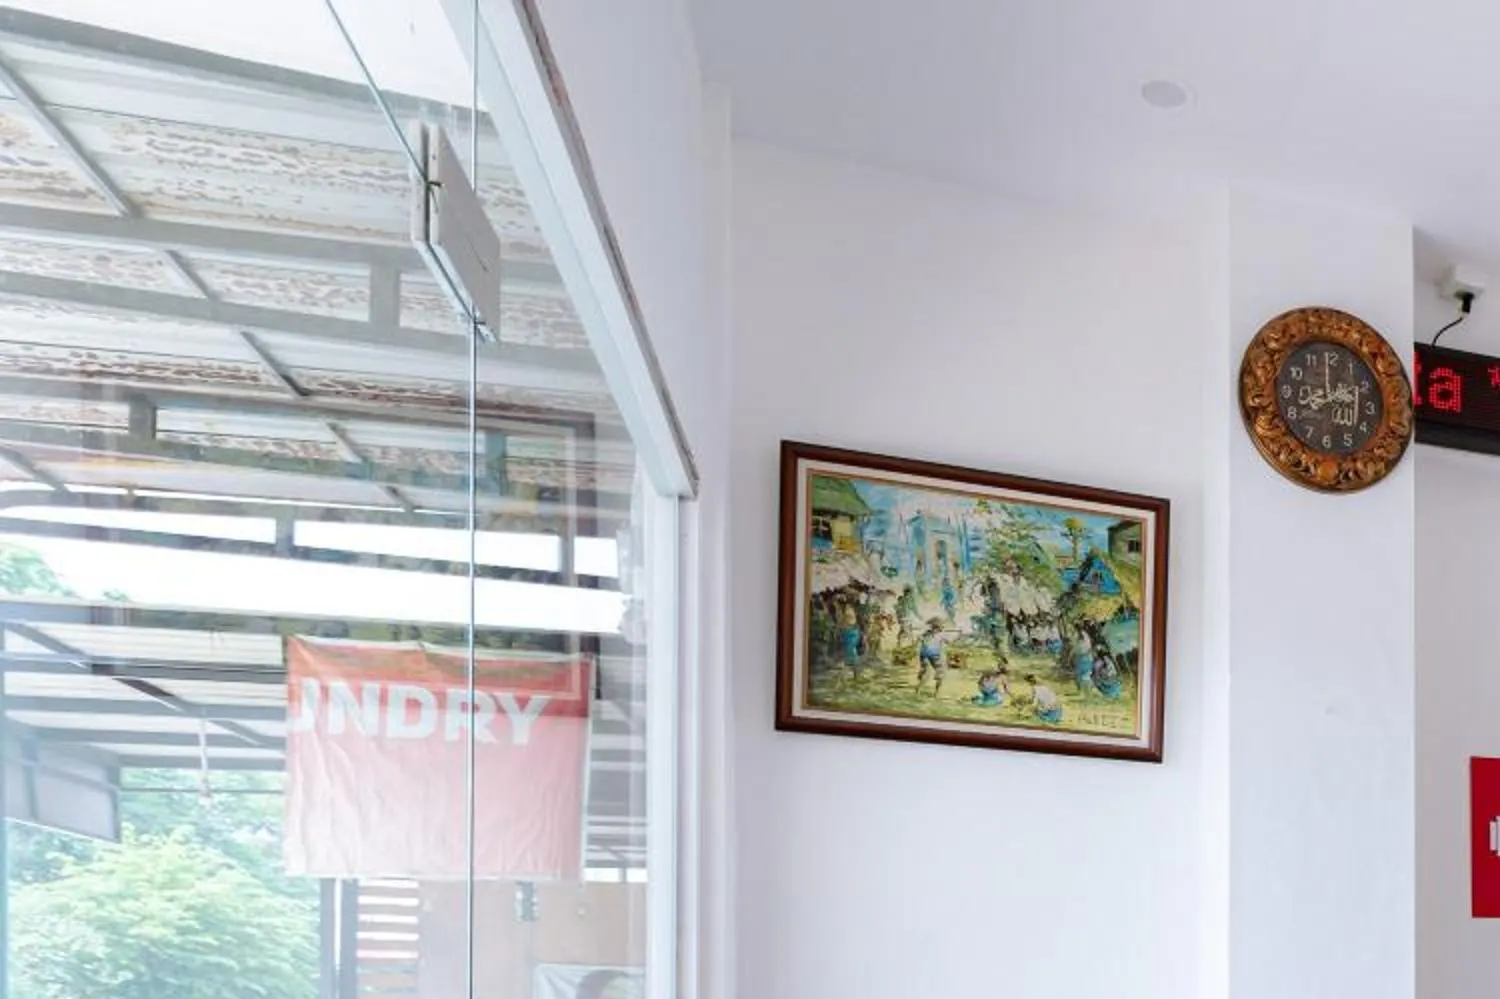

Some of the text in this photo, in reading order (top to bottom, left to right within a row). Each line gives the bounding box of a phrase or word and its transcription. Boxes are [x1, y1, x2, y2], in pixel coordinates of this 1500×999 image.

[1305, 353, 1317, 368] 11
[1290, 366, 1303, 380] 10
[1283, 384, 1292, 399] 9
[1360, 381, 1370, 393] 2
[1288, 406, 1297, 420] 8
[1365, 401, 1376, 415] 3
[1304, 426, 1314, 438] 7
[1359, 421, 1368, 433] 4
[1322, 435, 1332, 449] 6
[1344, 433, 1353, 447] 5
